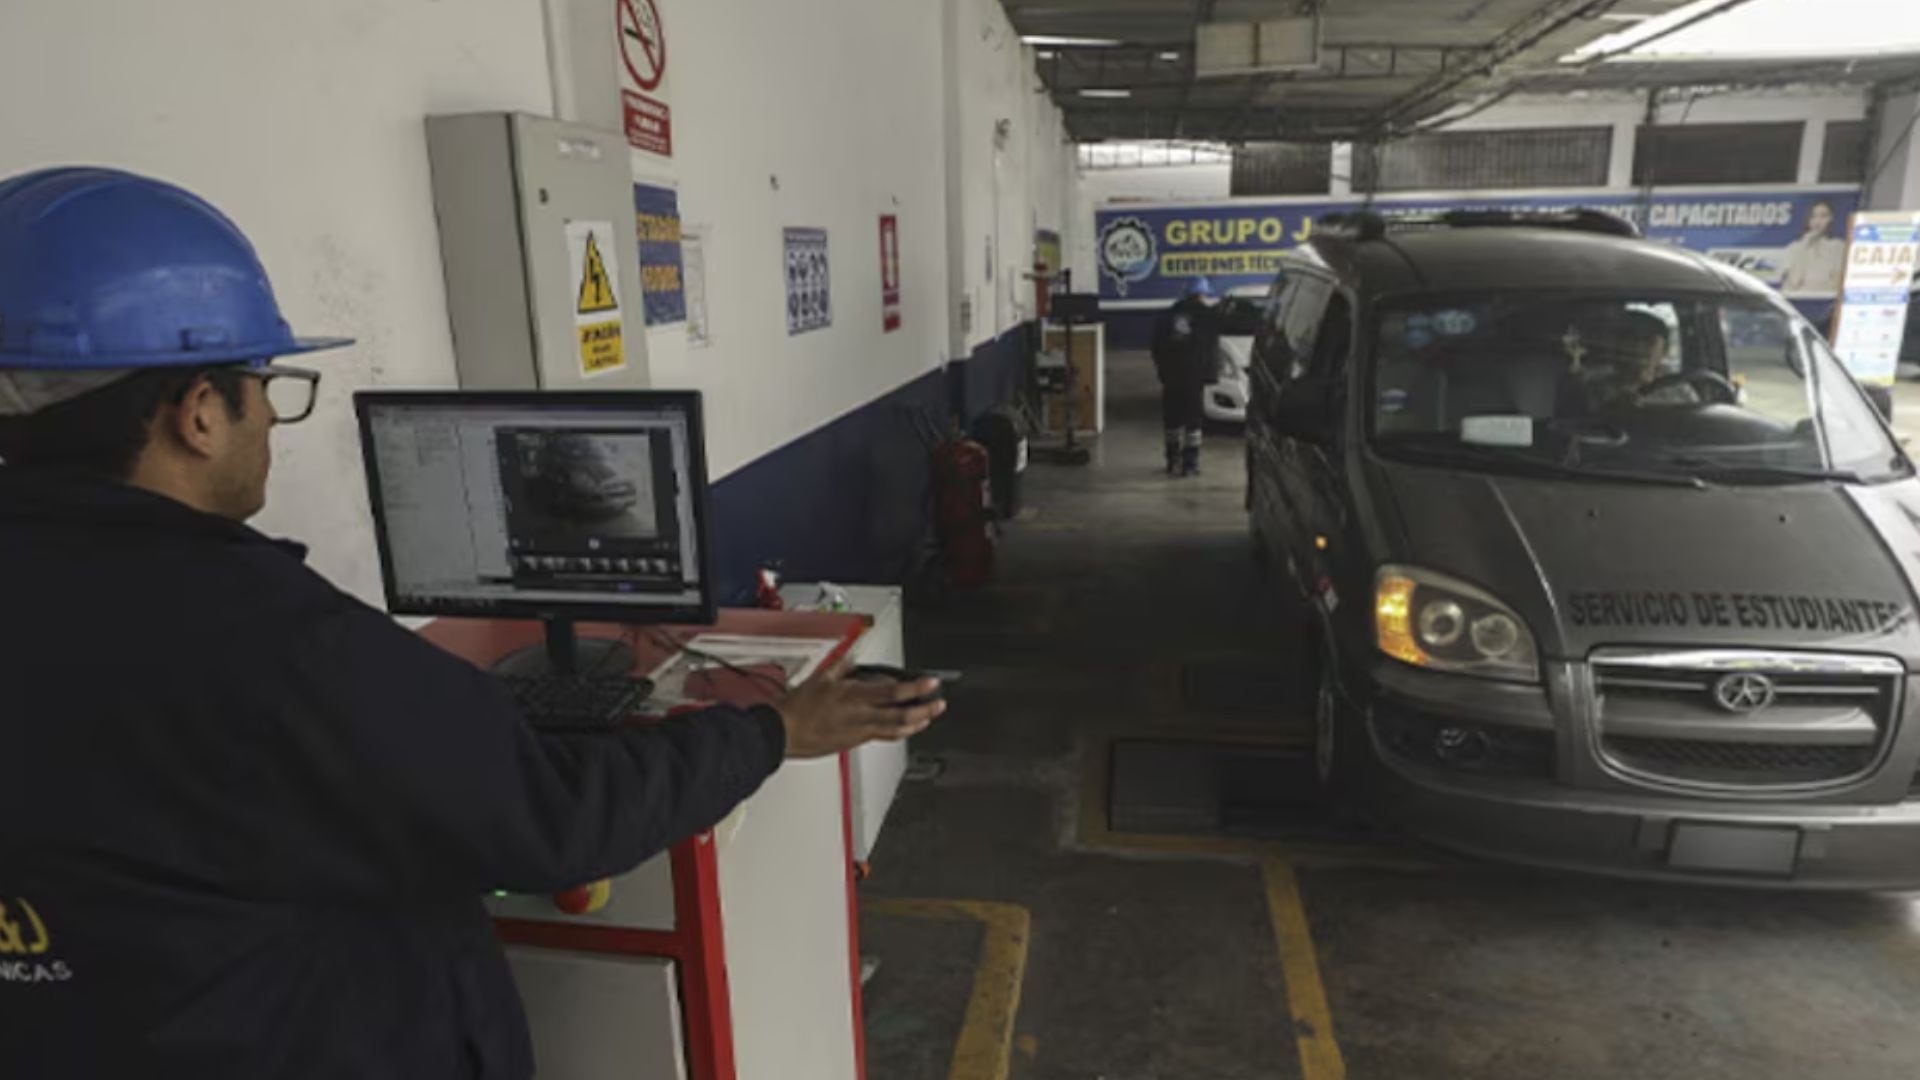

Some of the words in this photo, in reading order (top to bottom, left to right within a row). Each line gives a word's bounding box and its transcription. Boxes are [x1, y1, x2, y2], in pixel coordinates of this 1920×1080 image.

[1650, 202, 1793, 225] CAPACITADOS
[1165, 217, 1283, 245] GRUPO
[1853, 245, 1911, 265] CAJA
[1570, 592, 1687, 626] SERVICIO
[1692, 592, 1730, 626] DE
